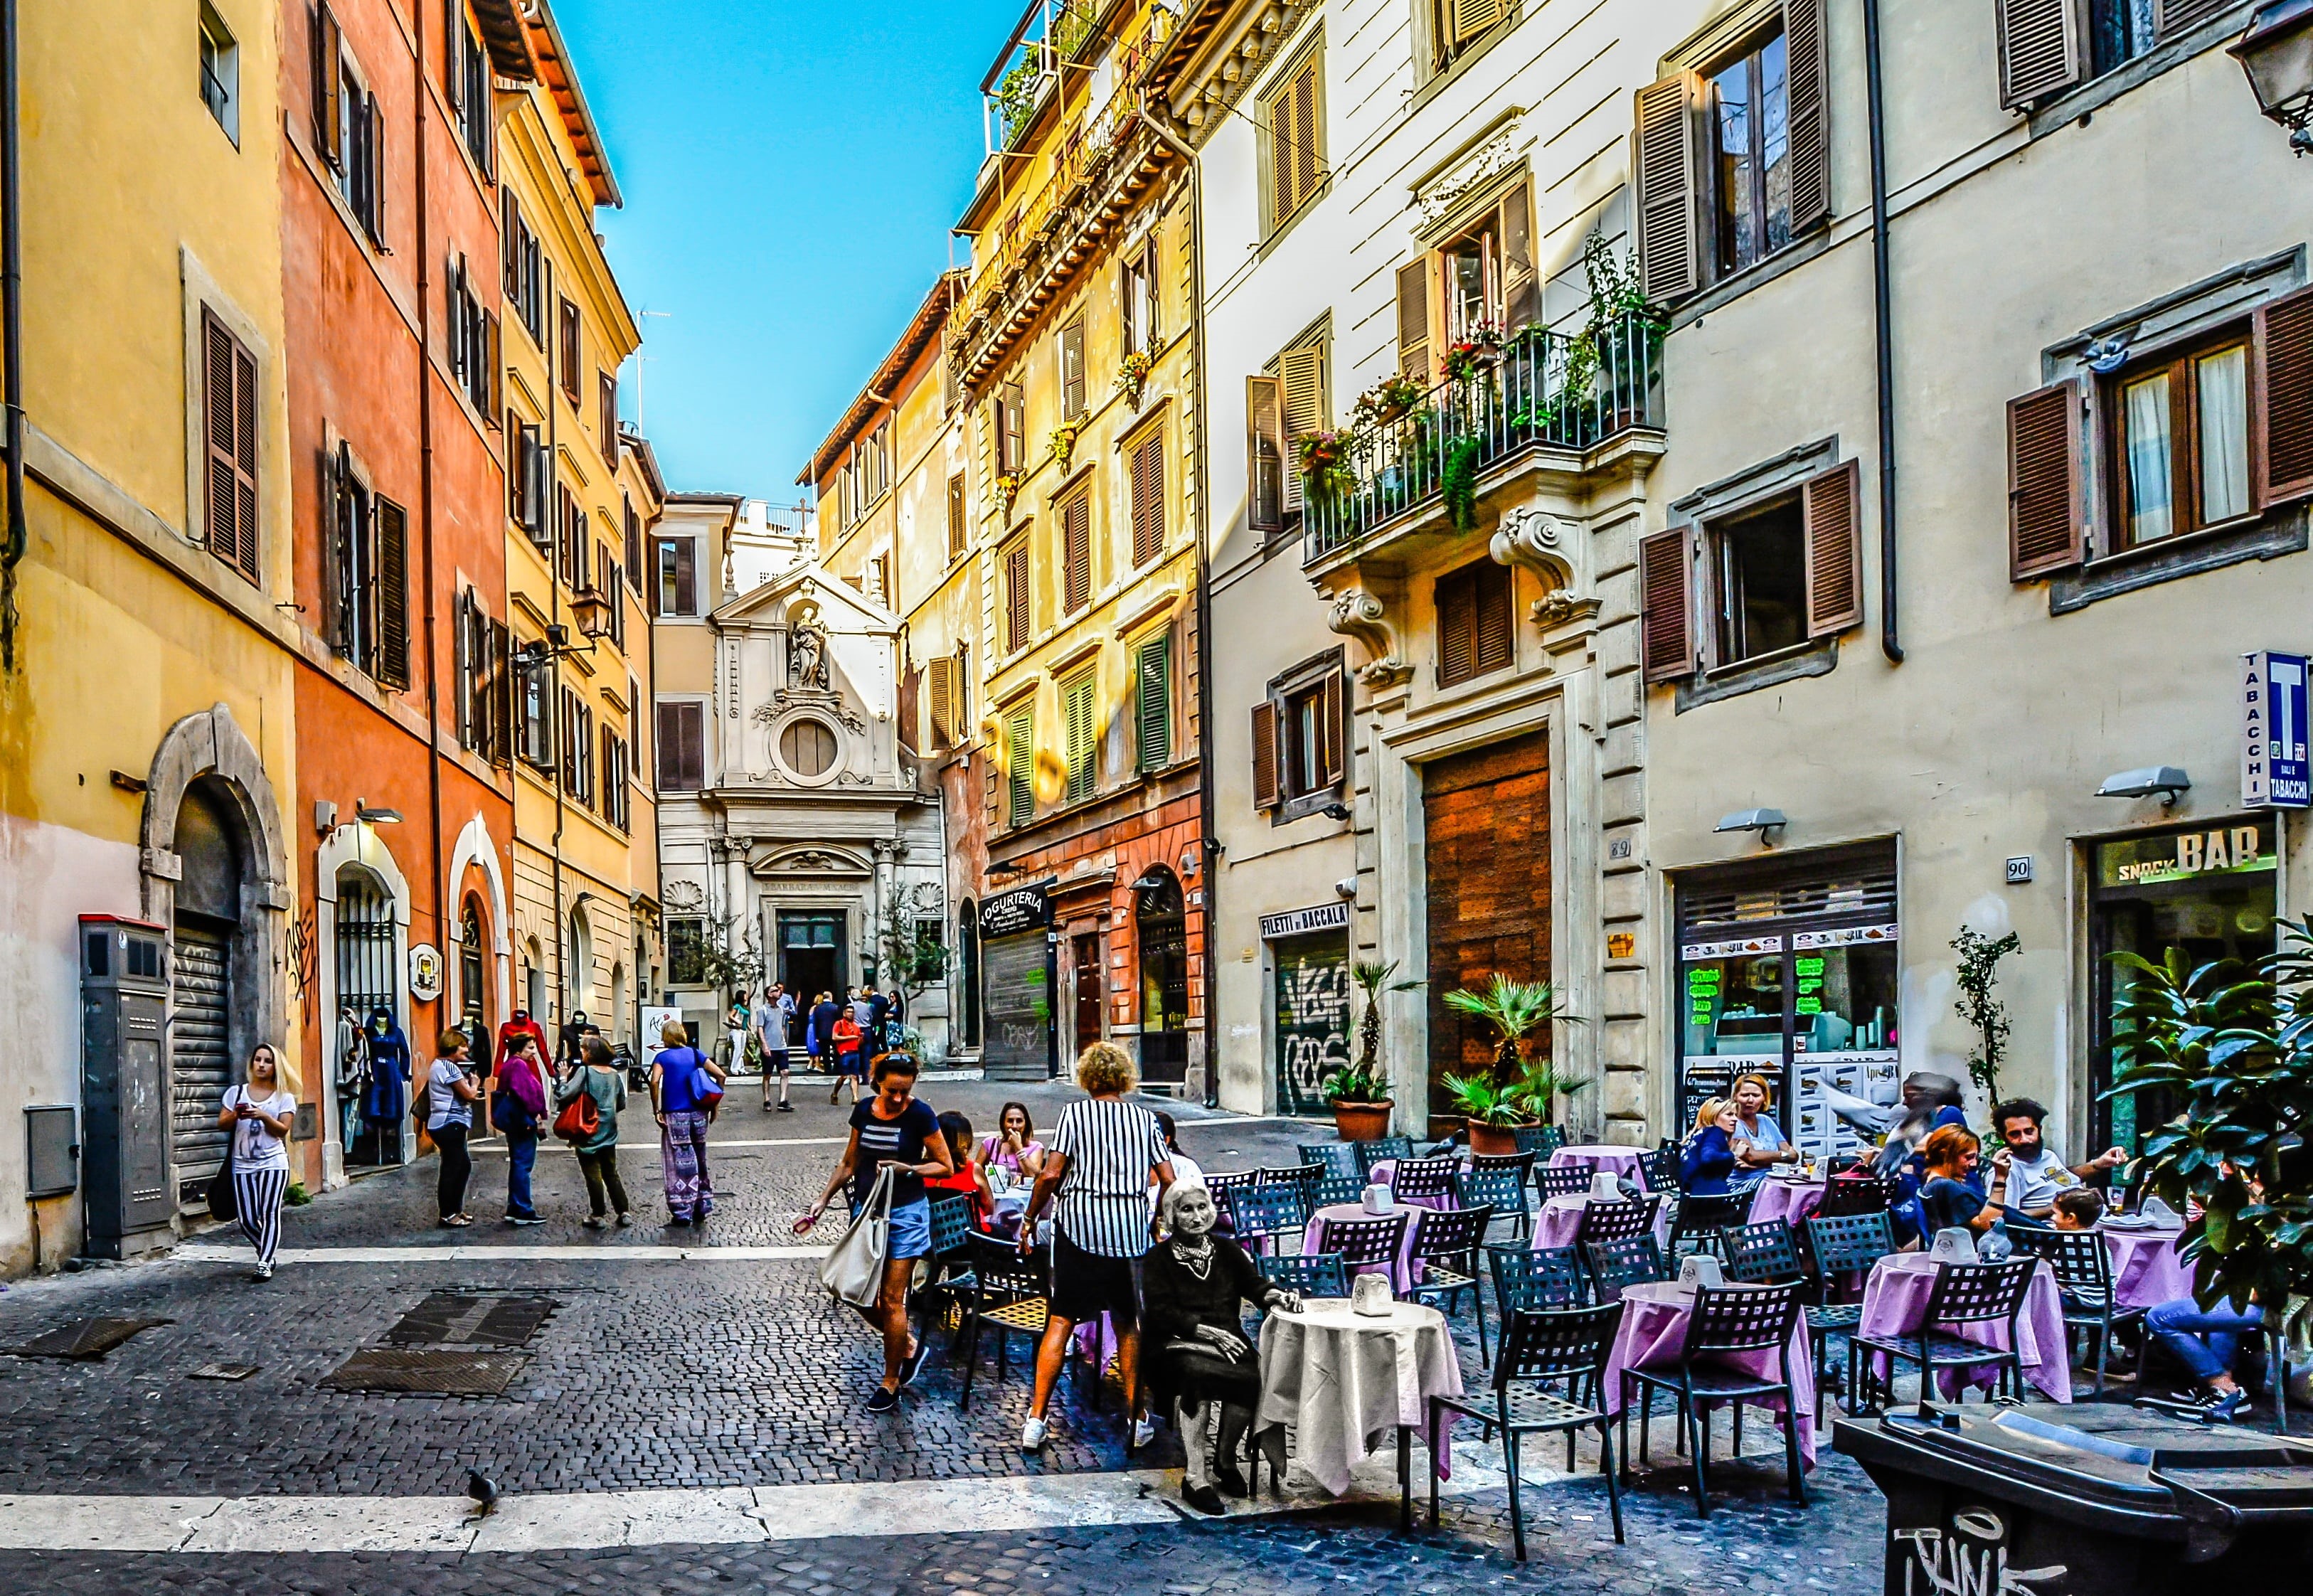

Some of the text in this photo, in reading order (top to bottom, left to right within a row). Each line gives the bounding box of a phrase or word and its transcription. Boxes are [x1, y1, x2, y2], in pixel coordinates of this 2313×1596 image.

[2245, 654, 2261, 792] TABACCHI
[2270, 661, 2301, 760] T
[2270, 779, 2307, 799] TABACCHI
[1611, 841, 1628, 856] 89
[2119, 826, 2258, 881] SNACK BAR
[2009, 862, 2027, 877] 90
[979, 891, 1042, 927] YOGURTERIA
[1261, 915, 1293, 935] FILETTI
